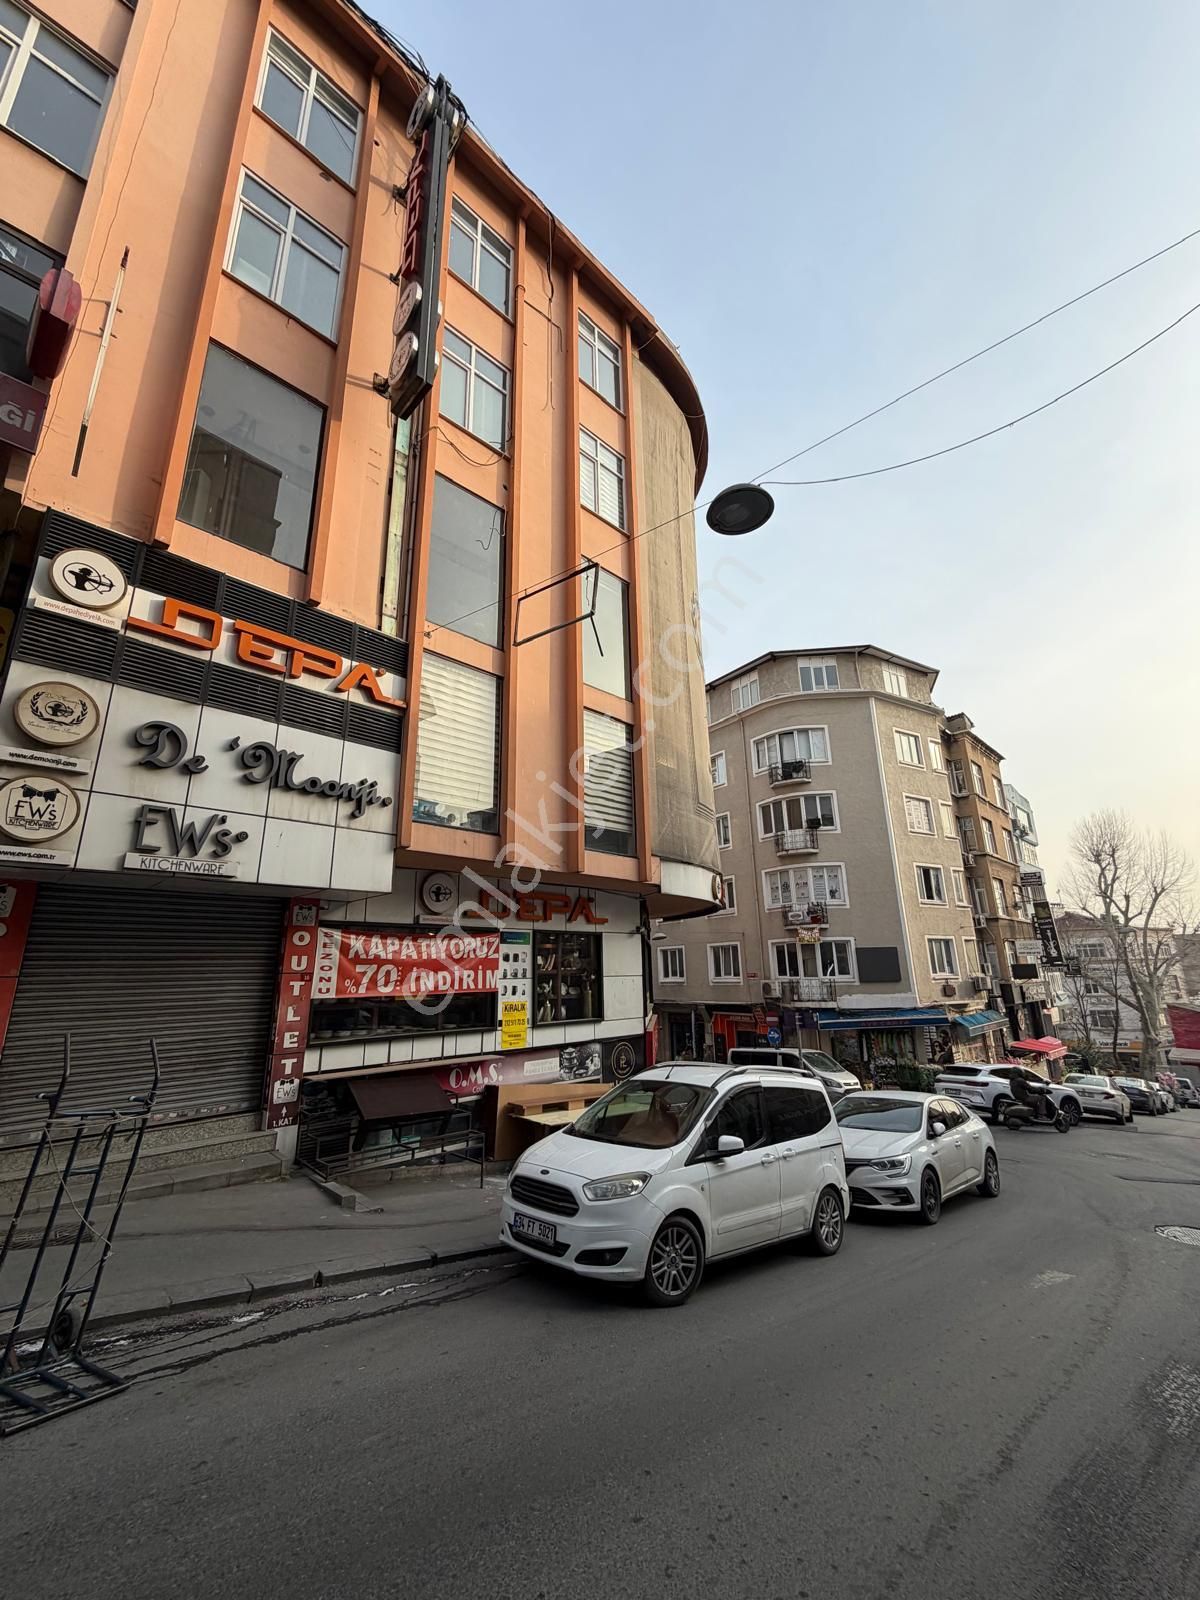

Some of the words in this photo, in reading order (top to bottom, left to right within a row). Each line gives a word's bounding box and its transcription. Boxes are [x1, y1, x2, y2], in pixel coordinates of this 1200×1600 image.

[126, 597, 407, 708] DEPA
[139, 856, 225, 876] KITCHENWARE
[461, 887, 609, 925] DEPA
[348, 934, 499, 961] KAPATIYORUZ
[317, 931, 335, 995] SEZONU
[410, 965, 499, 993] İNDİRİM
[279, 1117, 293, 1127] KAT
[527, 1219, 536, 1234] FT
[538, 1223, 554, 1241] 5021
